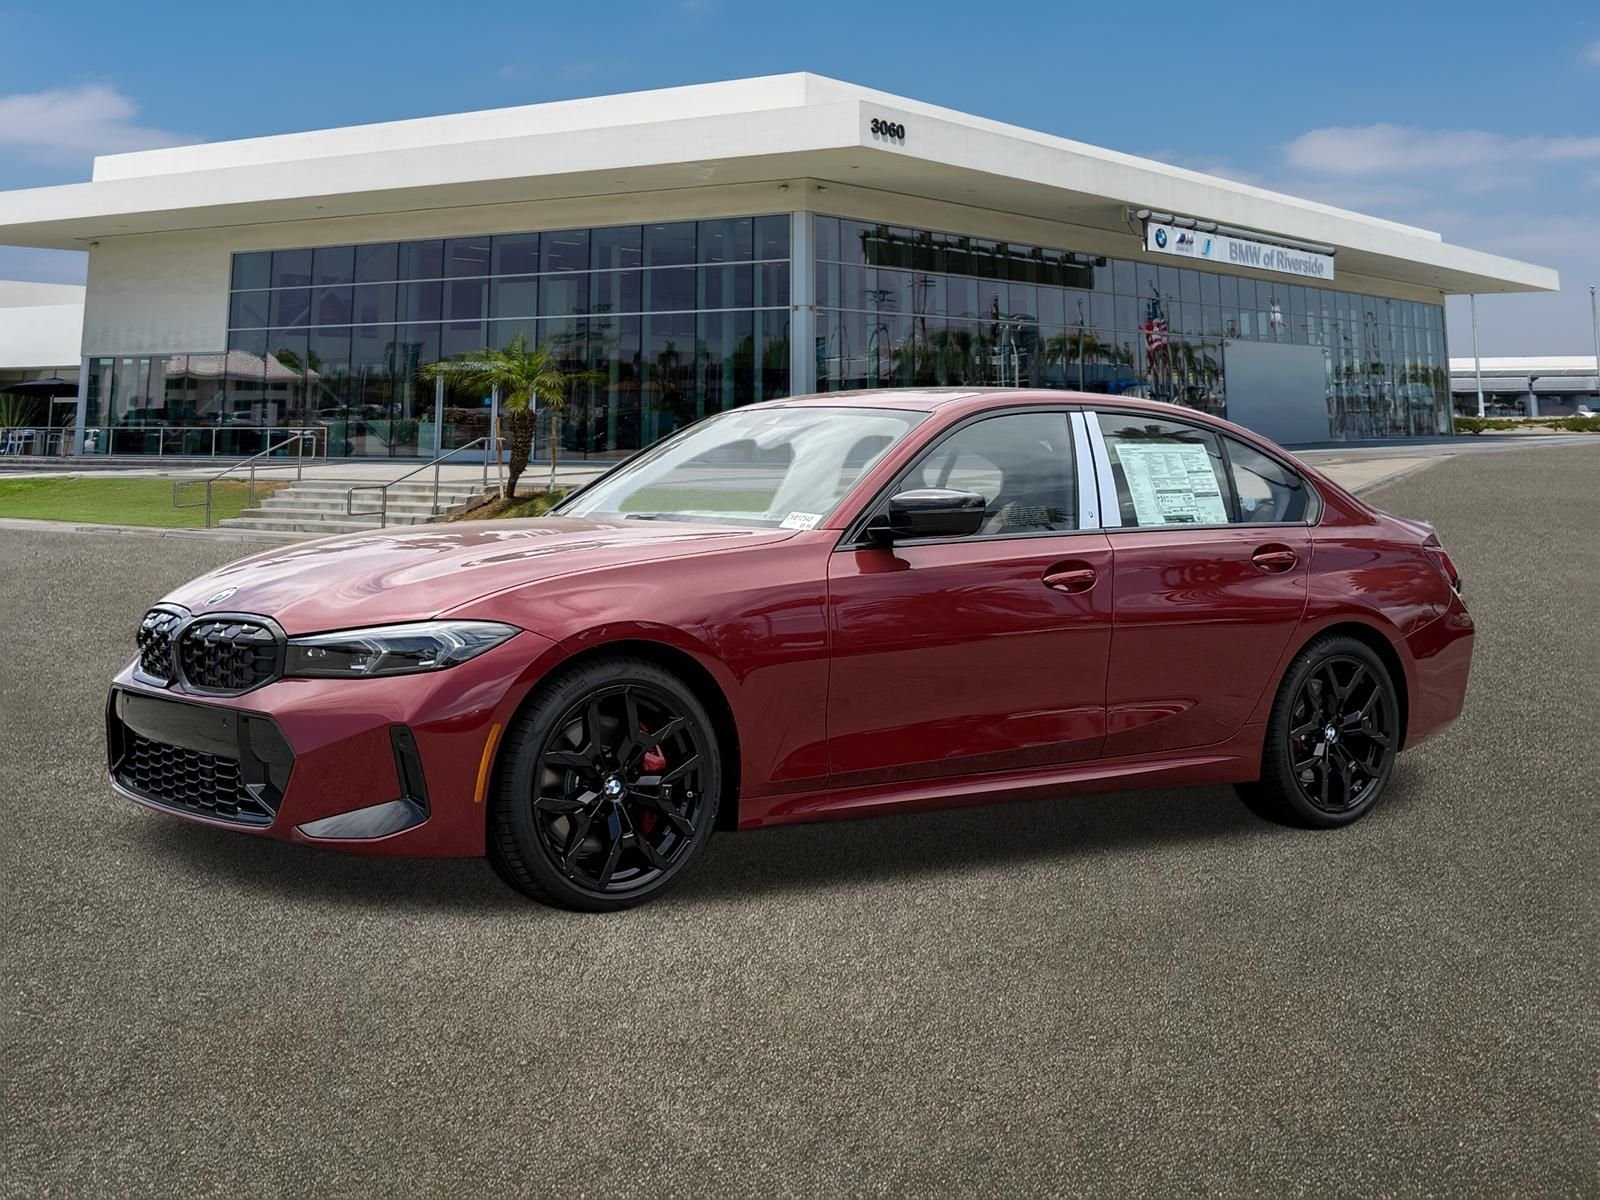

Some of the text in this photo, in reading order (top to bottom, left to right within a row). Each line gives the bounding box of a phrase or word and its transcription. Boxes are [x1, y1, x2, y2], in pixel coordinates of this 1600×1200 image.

[870, 118, 905, 140] 3060
[1229, 241, 1324, 275] BMW of Riverside
